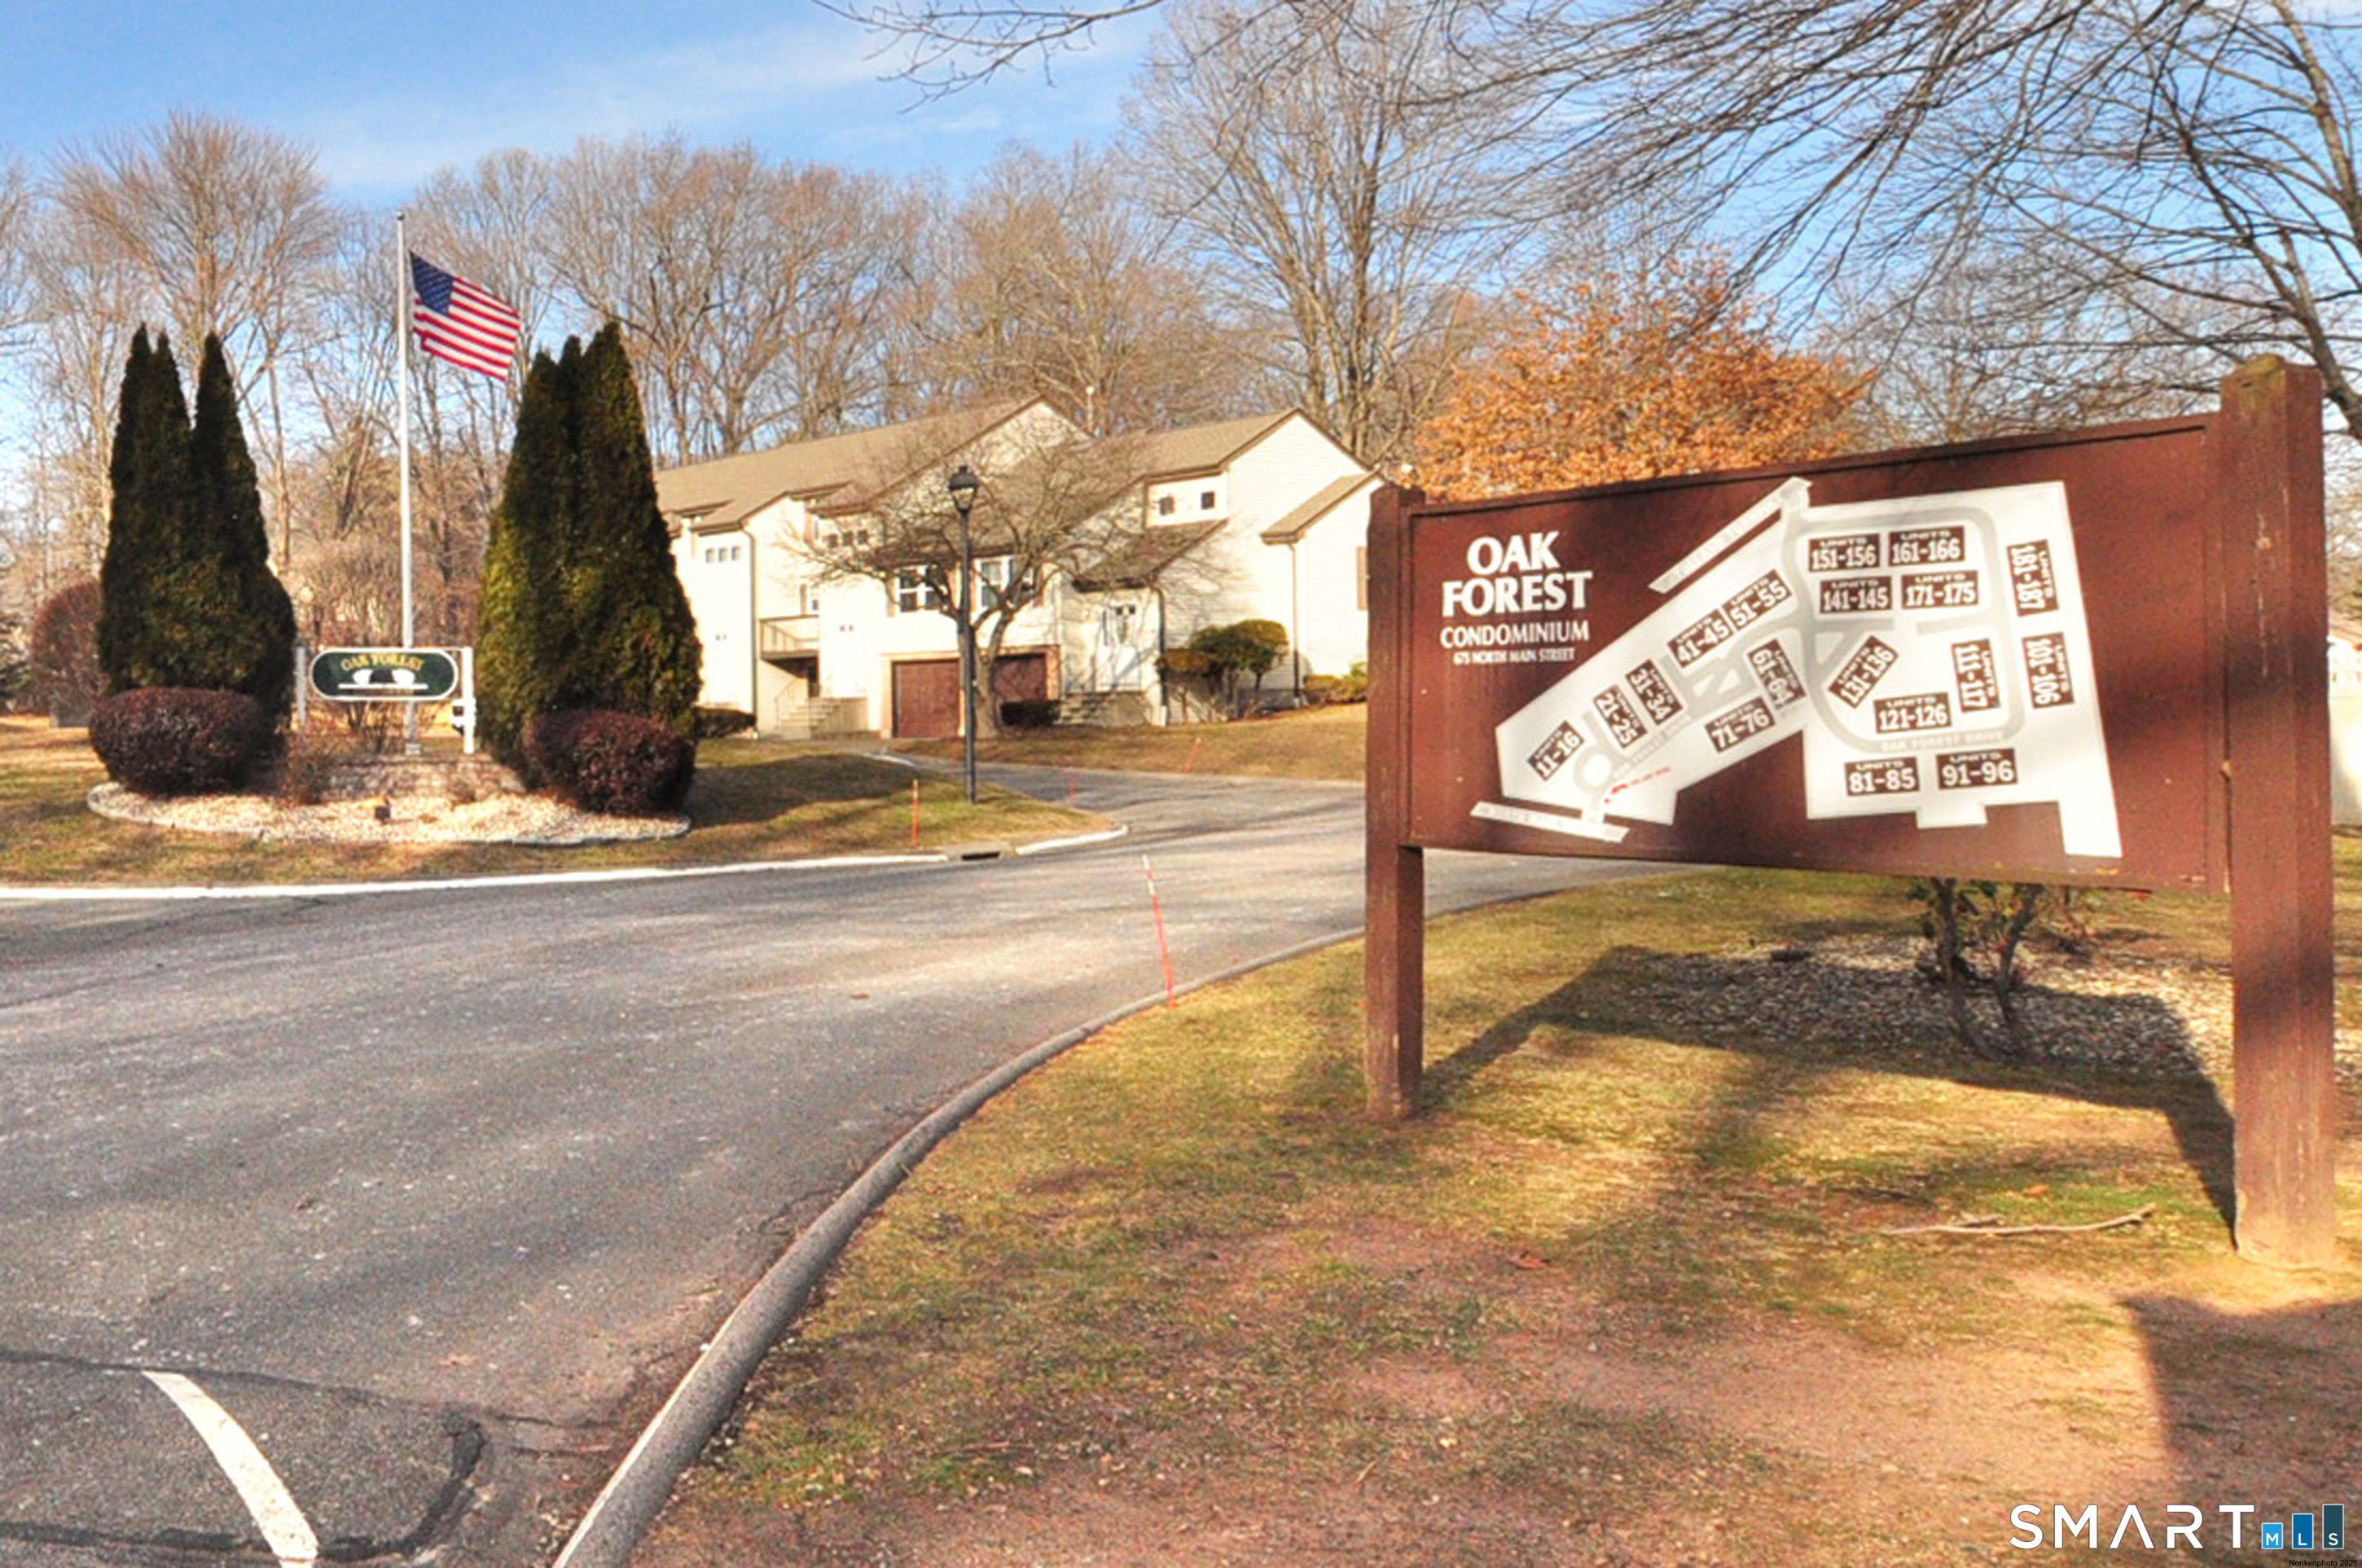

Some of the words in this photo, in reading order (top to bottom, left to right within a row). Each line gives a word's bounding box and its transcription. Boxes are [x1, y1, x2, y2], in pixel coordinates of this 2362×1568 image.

[1467, 531, 1561, 576] OAK
[1811, 544, 1876, 569] 151-156
[1892, 538, 1961, 563] 161-166
[1442, 571, 1593, 617] FOREST
[1907, 582, 1976, 606] 171-175
[2011, 545, 2046, 608] 181-187
[1729, 578, 1788, 627] 51-55
[1824, 586, 1888, 611] 141-145
[1440, 620, 1589, 648] CONDOMINIUM
[1509, 649, 1537, 662] MAIN
[1539, 647, 1575, 661] STREET
[1676, 617, 1730, 665] 41-45
[340, 656, 369, 671] OAK
[1840, 646, 1894, 704] 131-136
[1956, 644, 1987, 707] 111-117
[2026, 639, 2062, 705] 101-106
[1630, 667, 1672, 721] 31-34
[1596, 692, 1638, 744] 21-25
[1711, 708, 1771, 749] 71-76
[1879, 703, 1947, 731] 121-126
[1536, 730, 1580, 778] 11-16
[1943, 759, 2014, 787] 91-96
[1849, 766, 1916, 793] 81-85
